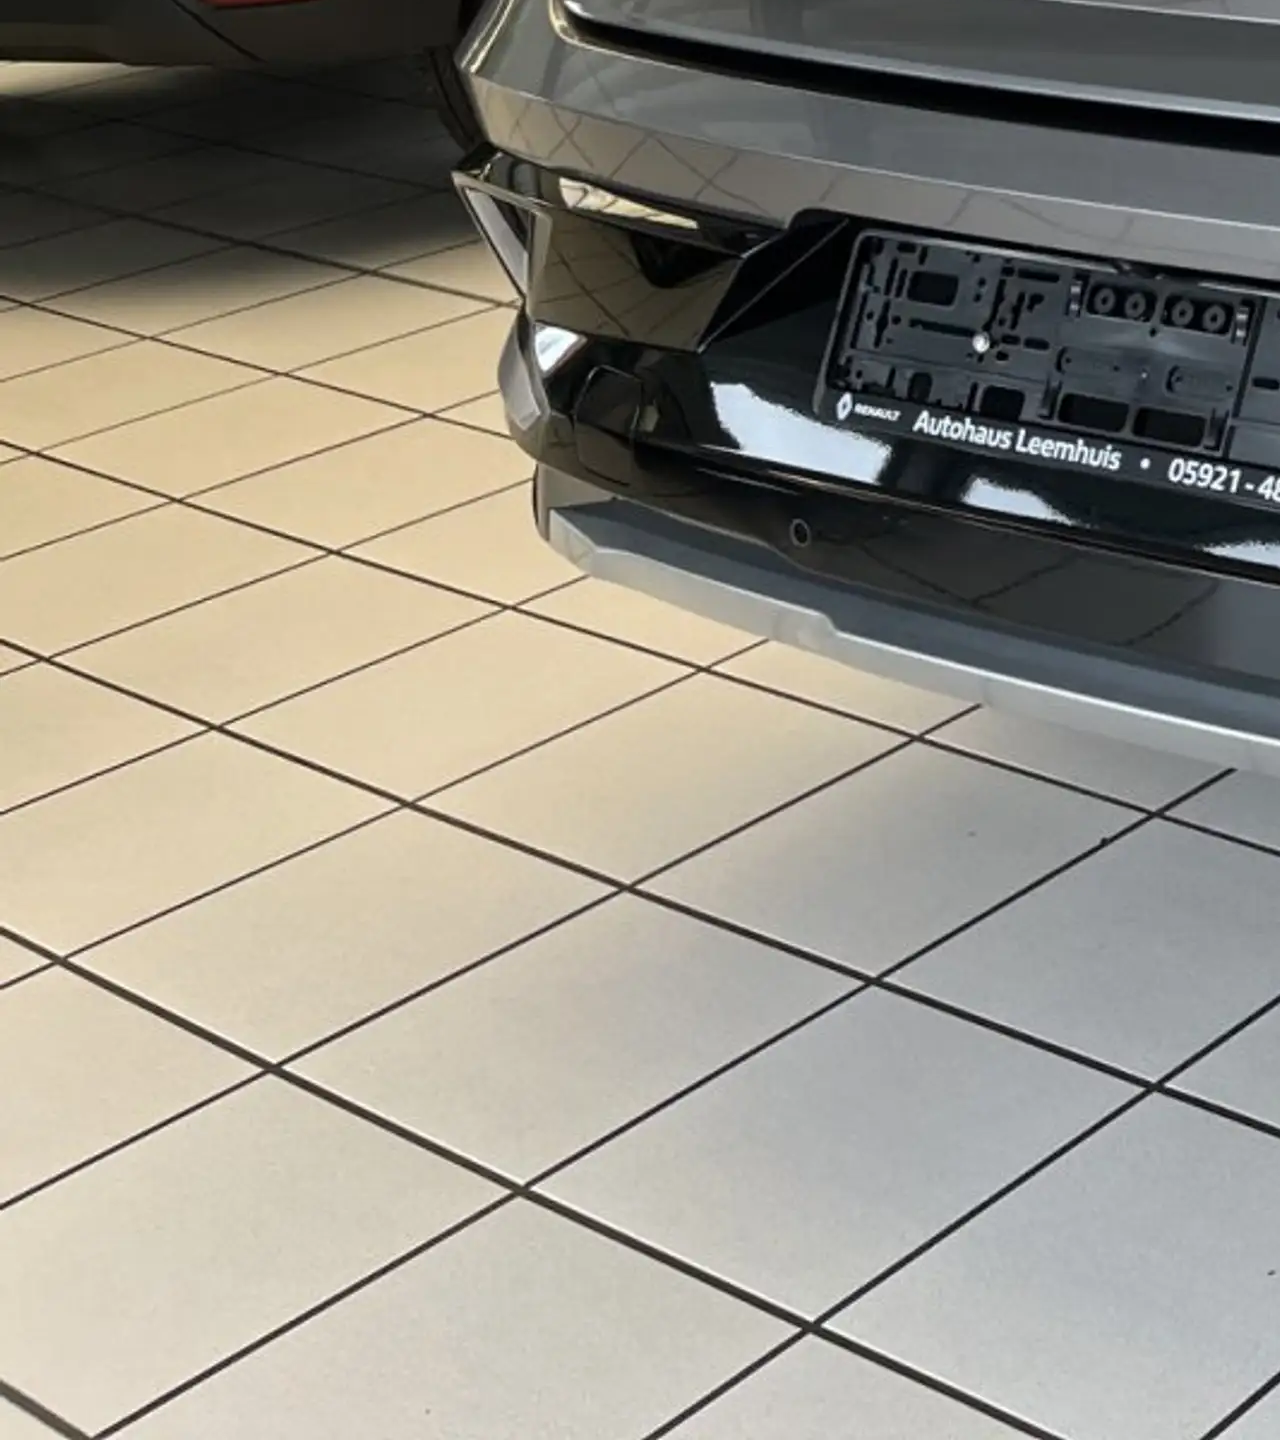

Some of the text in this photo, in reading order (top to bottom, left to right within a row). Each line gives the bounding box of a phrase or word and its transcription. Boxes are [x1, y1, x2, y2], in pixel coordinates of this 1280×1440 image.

[854, 402, 901, 421] RENAULT
[912, 410, 1013, 450] Autohaus
[1014, 428, 1123, 471] Leemhuis
